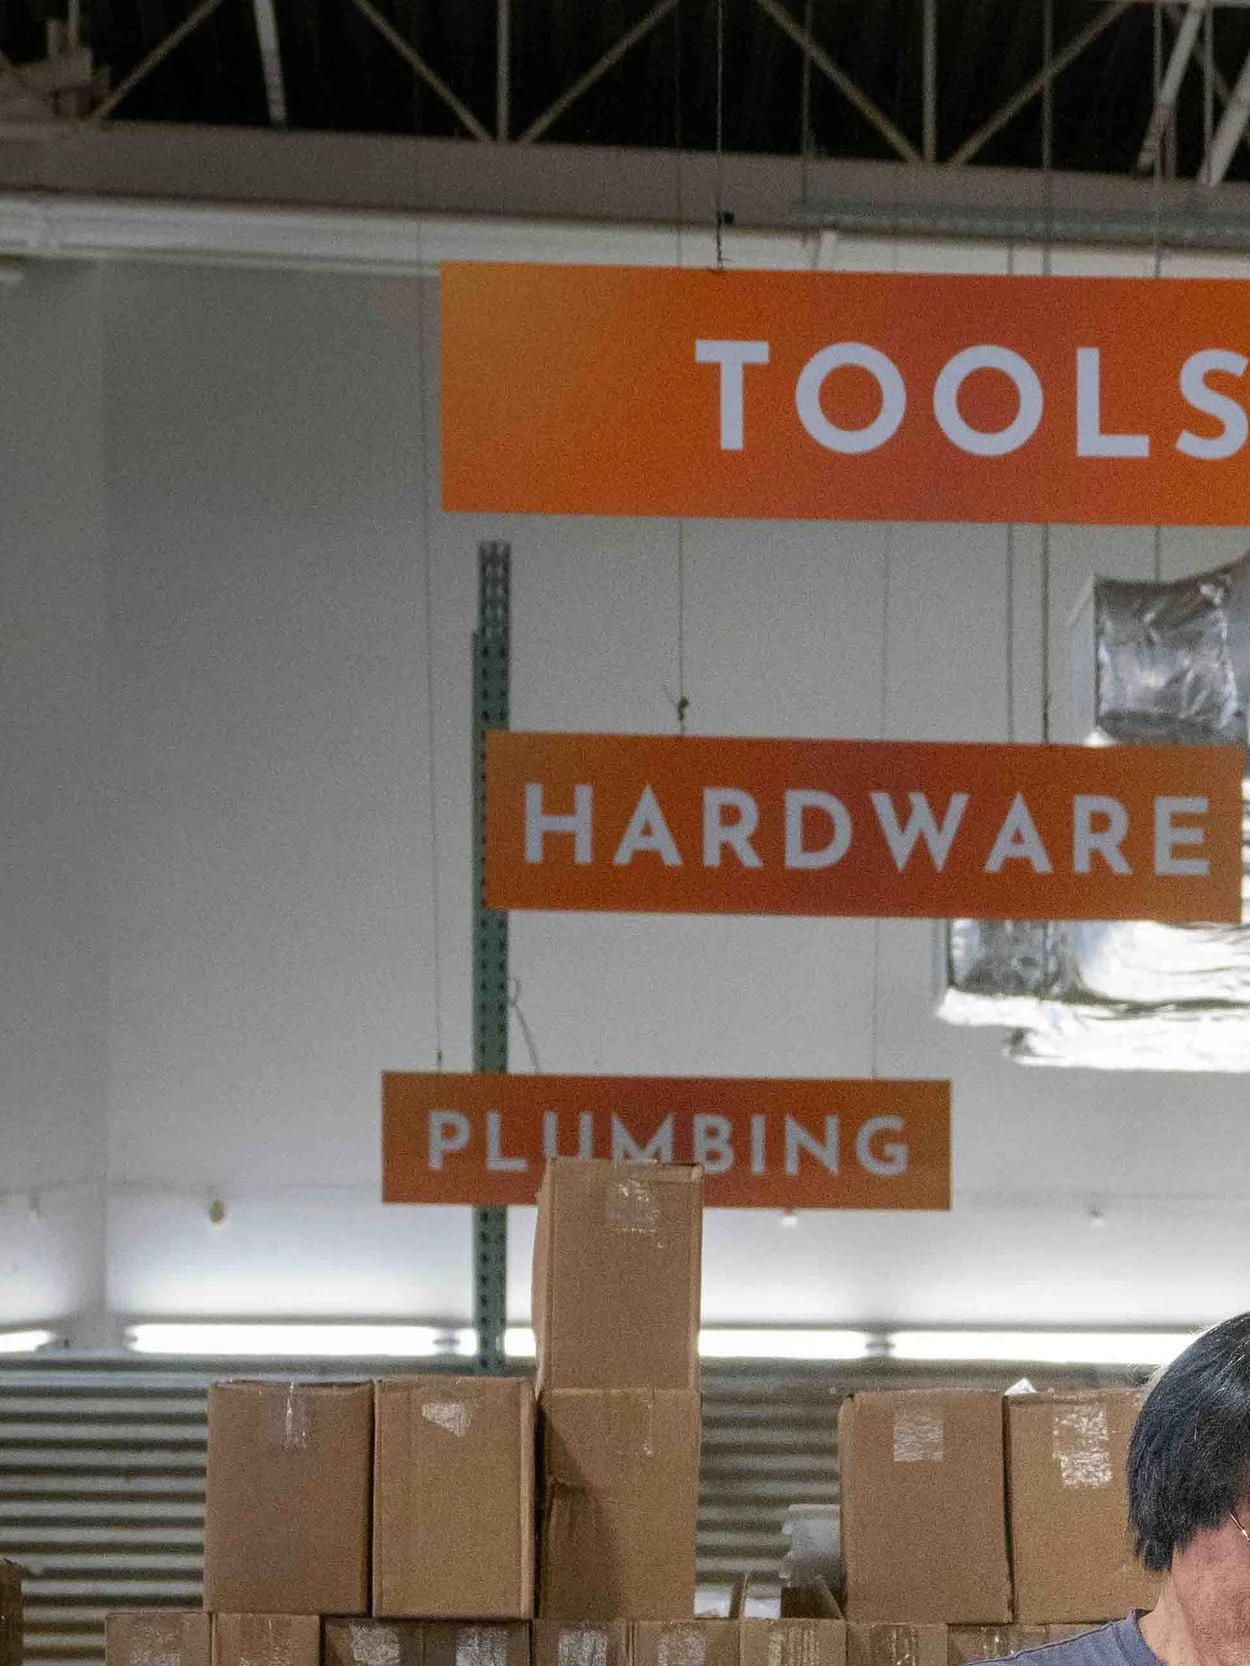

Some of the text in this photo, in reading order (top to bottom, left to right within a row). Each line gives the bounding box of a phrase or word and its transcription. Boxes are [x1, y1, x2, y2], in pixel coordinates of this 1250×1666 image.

[695, 337, 1250, 460] TOOLS
[522, 783, 1211, 876] HARDWARE
[426, 1109, 910, 1176] PLUMBING
